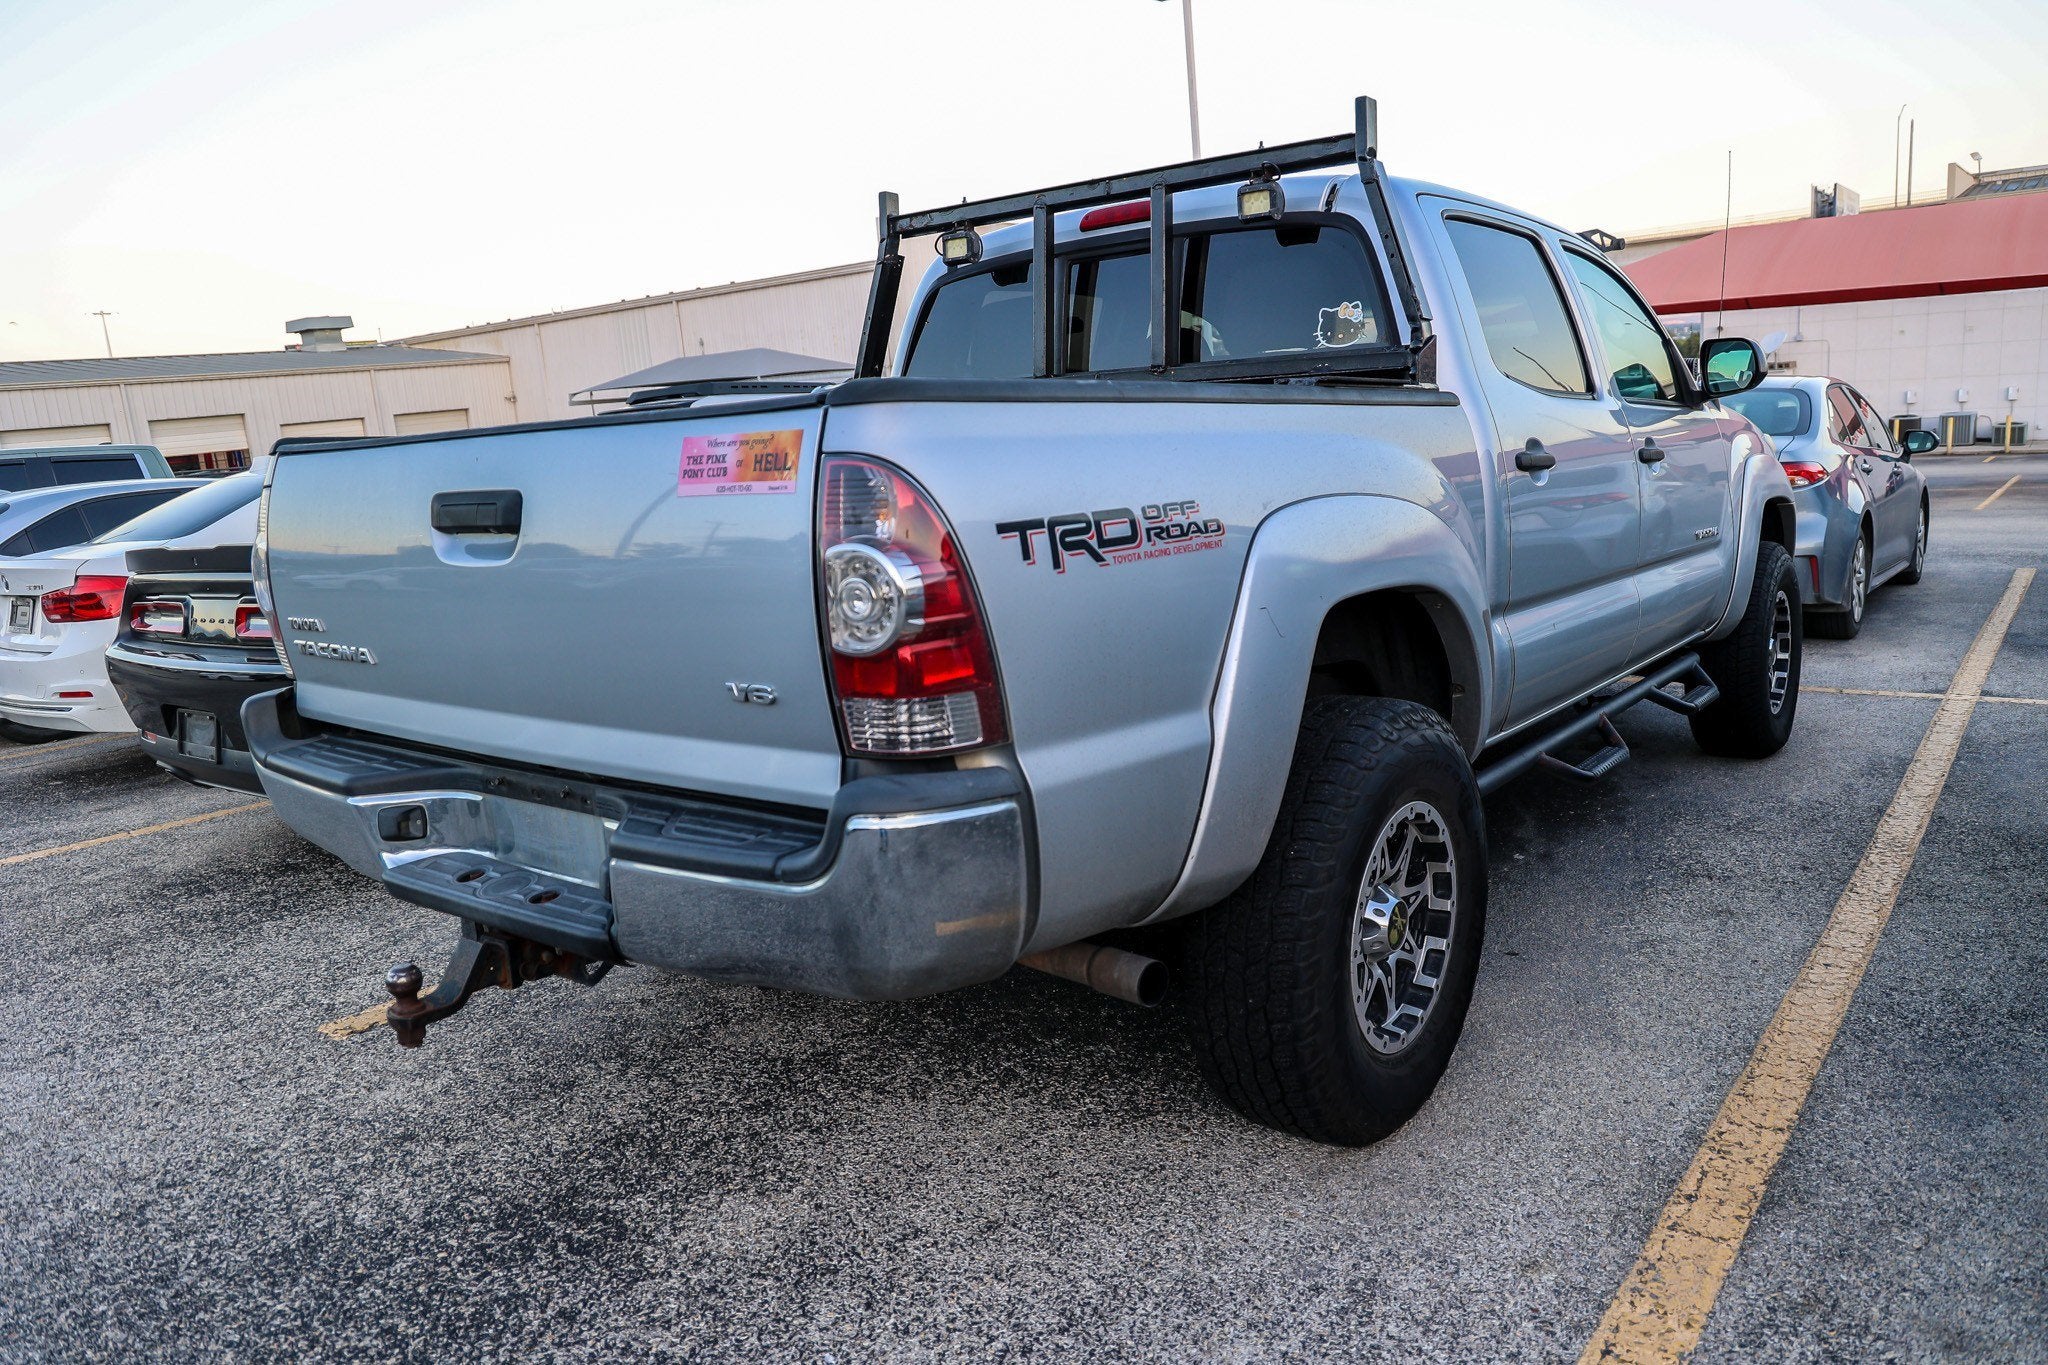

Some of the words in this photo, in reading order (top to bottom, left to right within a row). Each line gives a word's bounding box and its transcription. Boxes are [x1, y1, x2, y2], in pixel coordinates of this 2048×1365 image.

[686, 455, 704, 466] THE
[706, 454, 727, 464] PINK
[753, 452, 792, 472] HELL
[682, 468, 705, 479] PONY
[707, 467, 728, 478] CLUB
[1141, 500, 1200, 524] OFF
[996, 506, 1143, 574] TRD
[1145, 518, 1226, 546] ROAD
[1112, 552, 1142, 565] TOYOTA
[1143, 547, 1171, 560] RACING
[1172, 540, 1224, 556] DEVELOPMENT
[287, 616, 327, 632] TOYOTA
[293, 639, 378, 665] TACOMA
[725, 682, 777, 705] V6
